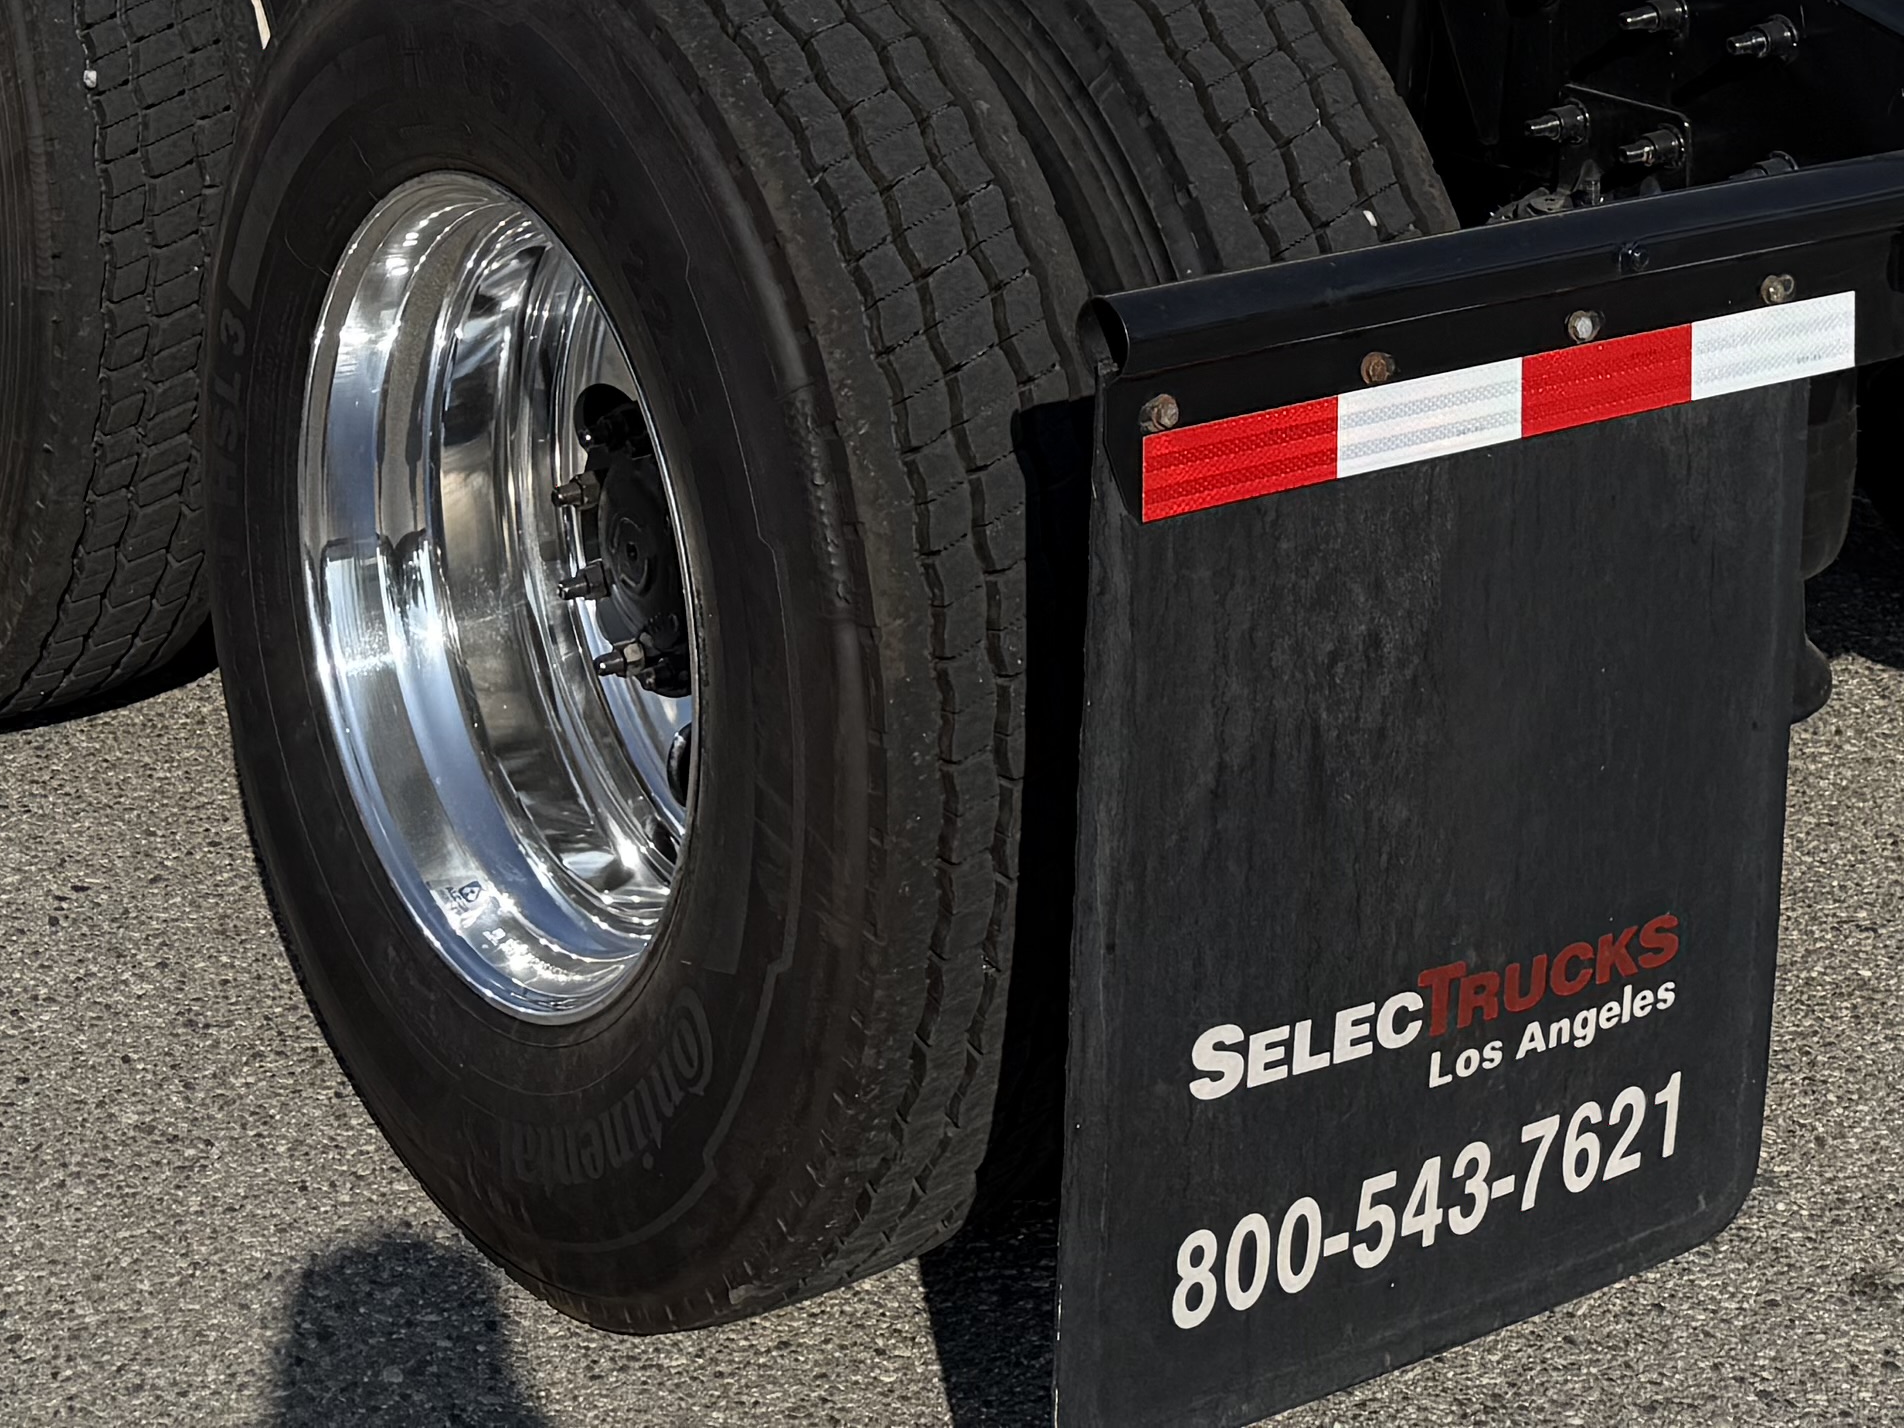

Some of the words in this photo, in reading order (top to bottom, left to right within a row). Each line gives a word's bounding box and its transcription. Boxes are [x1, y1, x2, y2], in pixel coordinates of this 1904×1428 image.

[1428, 1040, 1503, 1088] Los
[1515, 981, 1676, 1060] Angeles
[1171, 1071, 1682, 1329] 800-543-7621
